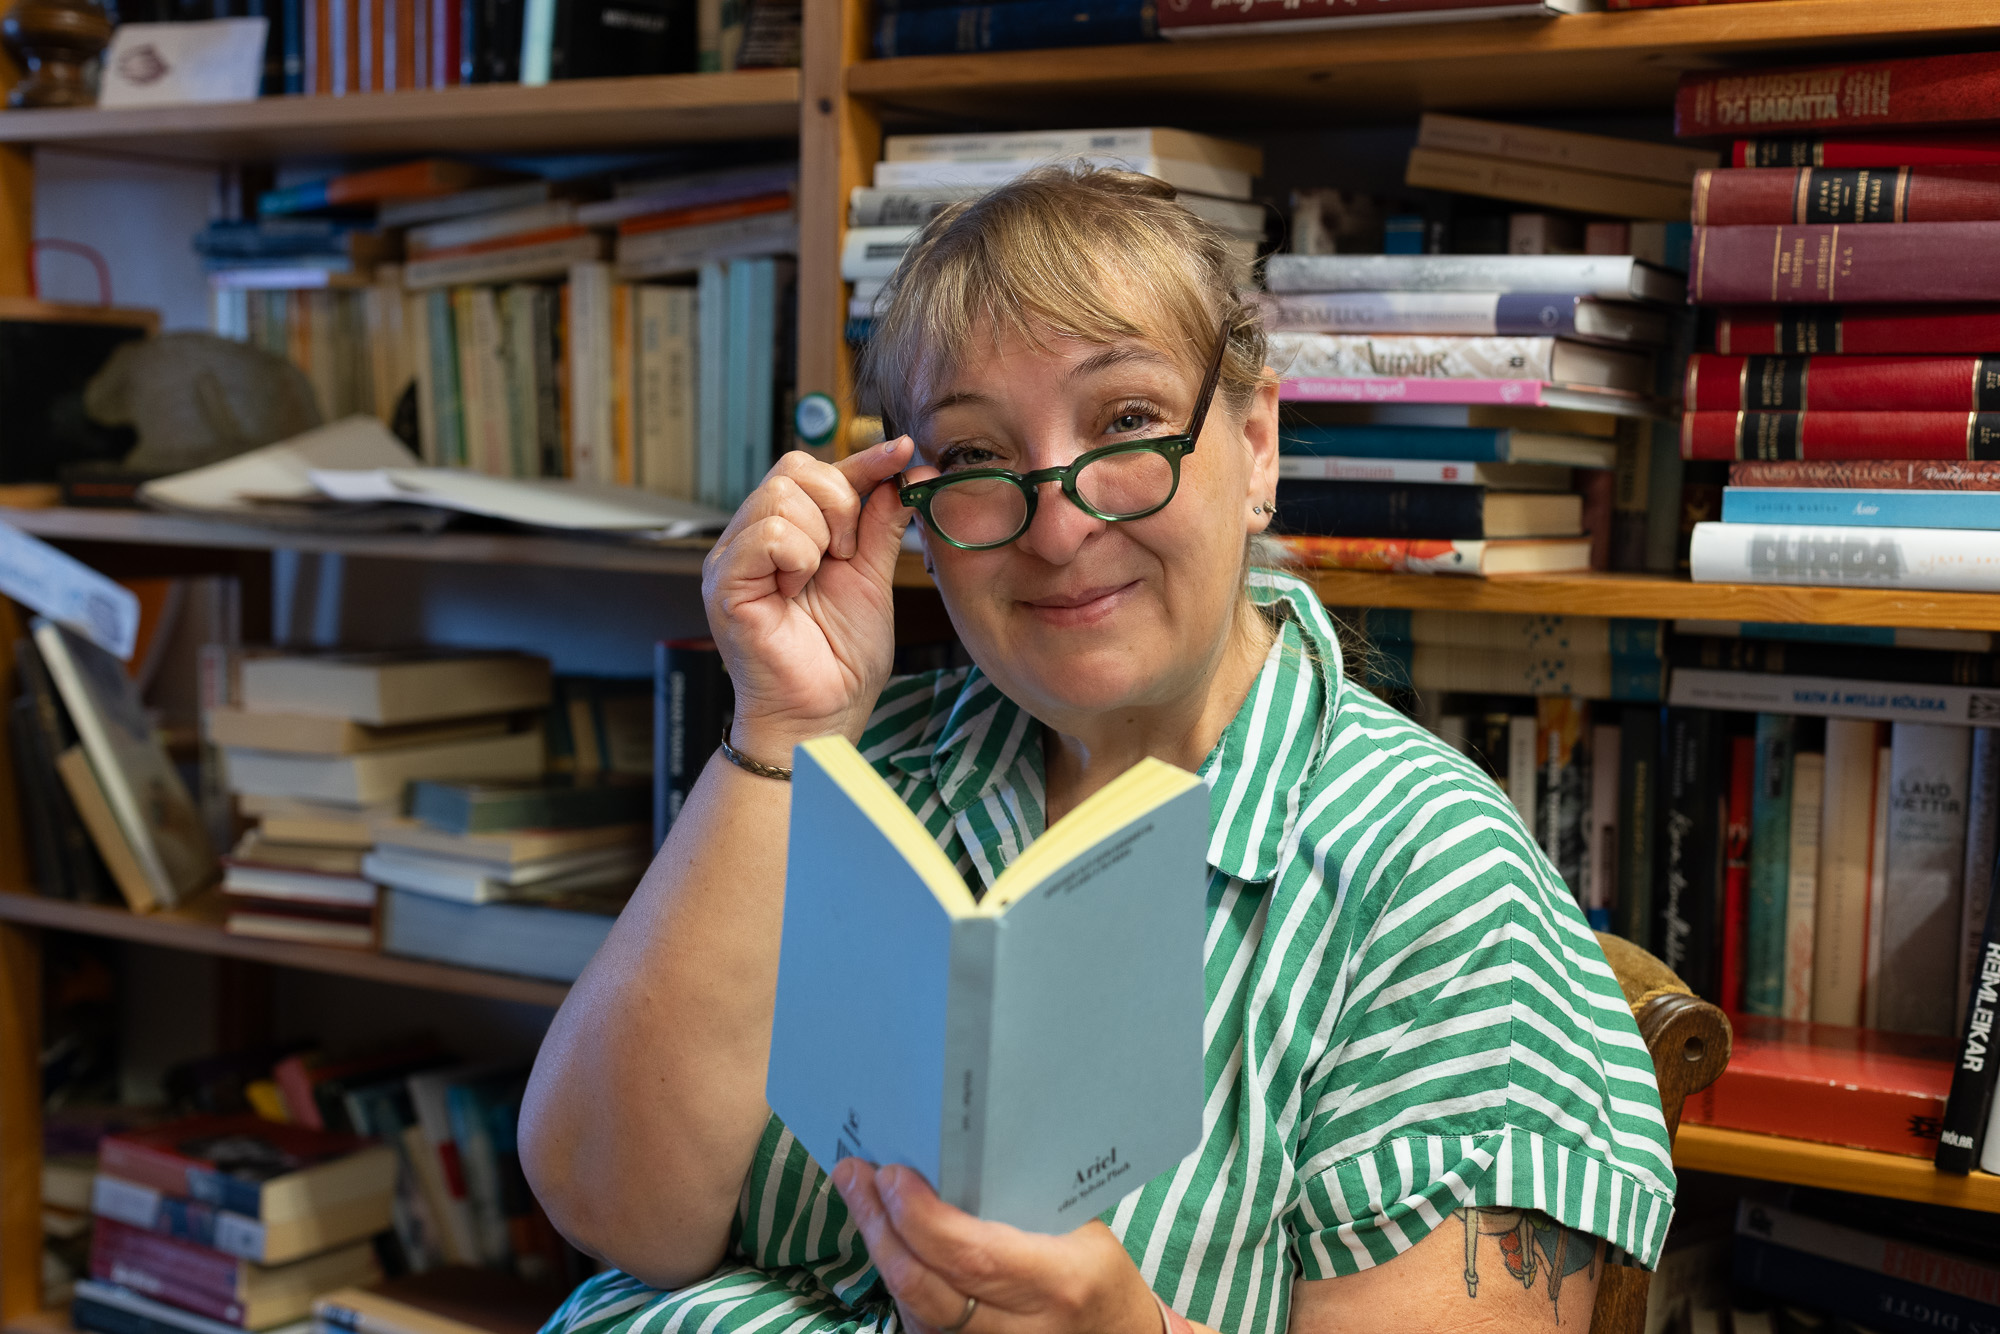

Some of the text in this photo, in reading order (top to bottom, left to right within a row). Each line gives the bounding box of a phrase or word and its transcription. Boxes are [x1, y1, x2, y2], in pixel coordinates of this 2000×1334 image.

[1797, 465, 1852, 481] VARGAS
[1854, 466, 1901, 481] LLOSA
[1765, 547, 1887, 565] blinda
[1072, 1146, 1116, 1189] Ariel
